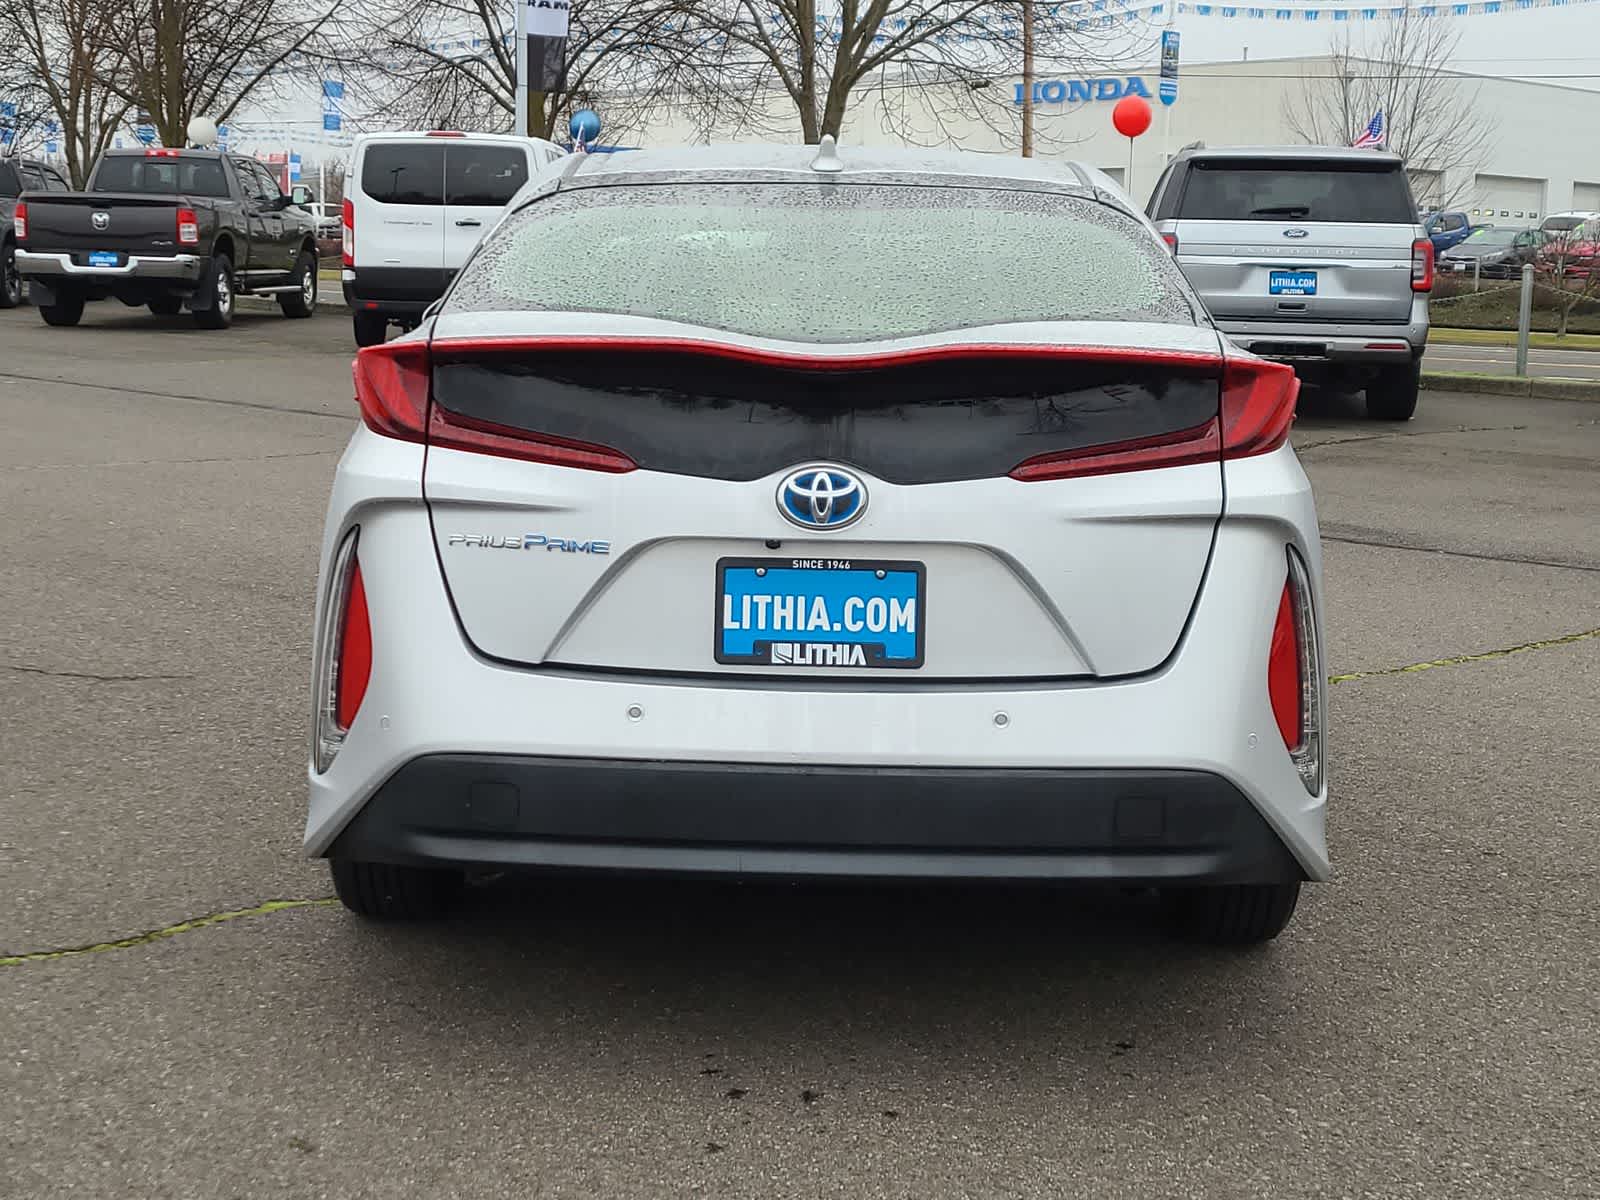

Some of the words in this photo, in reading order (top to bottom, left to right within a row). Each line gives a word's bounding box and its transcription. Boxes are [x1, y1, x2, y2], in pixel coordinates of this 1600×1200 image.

[528, 0, 568, 10] RAM
[1014, 77, 1152, 105] HONDA
[1271, 278, 1316, 289] LITHIA.COM
[449, 533, 521, 549] PRIUS
[524, 532, 611, 554] PRIME
[792, 559, 824, 570] SINCE
[827, 560, 851, 570] 1946
[723, 594, 916, 633] LITHIA.COM
[793, 643, 867, 666] LITHIA
